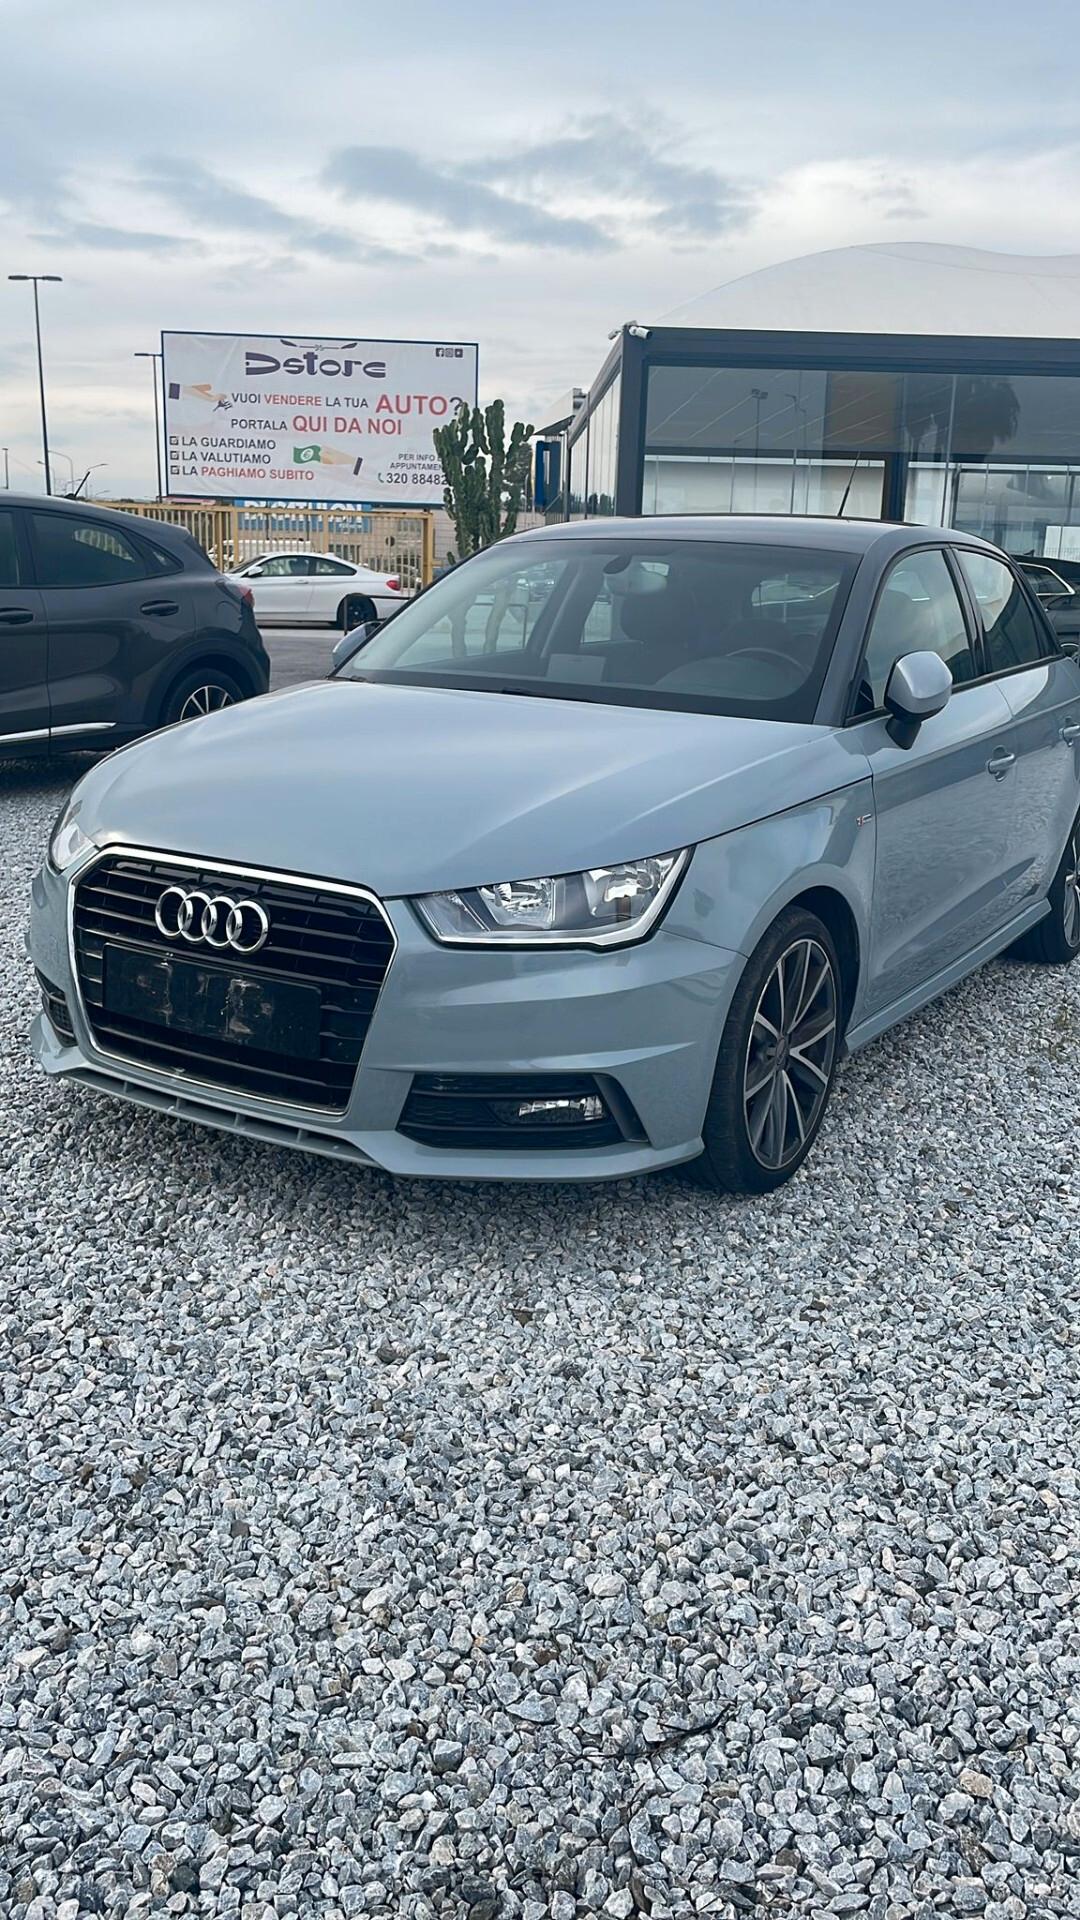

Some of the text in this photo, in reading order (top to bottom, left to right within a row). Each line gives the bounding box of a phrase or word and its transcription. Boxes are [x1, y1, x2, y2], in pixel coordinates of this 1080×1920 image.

[231, 393, 463, 416] VUOI VENDERE LA TUA AUTO?
[231, 415, 402, 435] PORTALA QUI DA NOI
[182, 436, 276, 450] LA GUARDIAMO
[182, 451, 271, 464] LA VALUTIAMO
[398, 453, 414, 461] PER
[416, 454, 436, 462] INFO
[182, 466, 315, 481] LA PAGHIAMO SUBITO
[386, 472, 408, 484] 320
